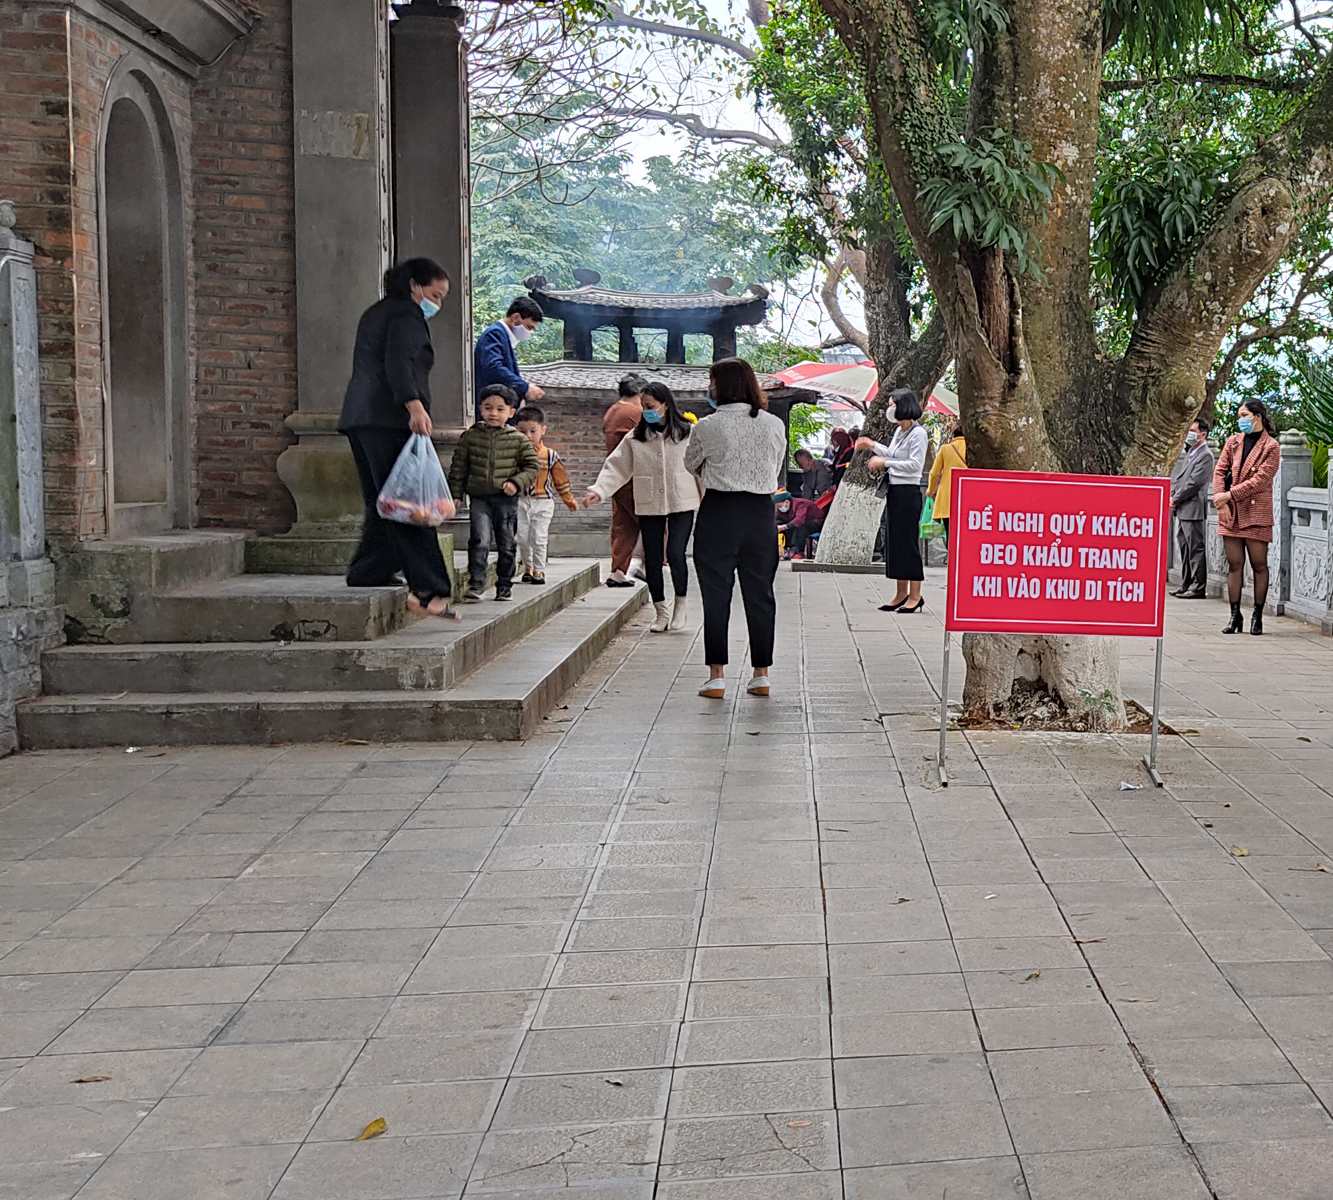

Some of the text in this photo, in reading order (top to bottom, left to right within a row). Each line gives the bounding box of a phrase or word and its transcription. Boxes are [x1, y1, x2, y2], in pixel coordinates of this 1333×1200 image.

[968, 505, 1154, 538] ĐỀ NGHỊ QUÝ KHÁCH
[980, 538, 1138, 570] ĐEO KHẨU TRANG
[972, 573, 1145, 602] KHI VÀO KHU DI TÍCH
